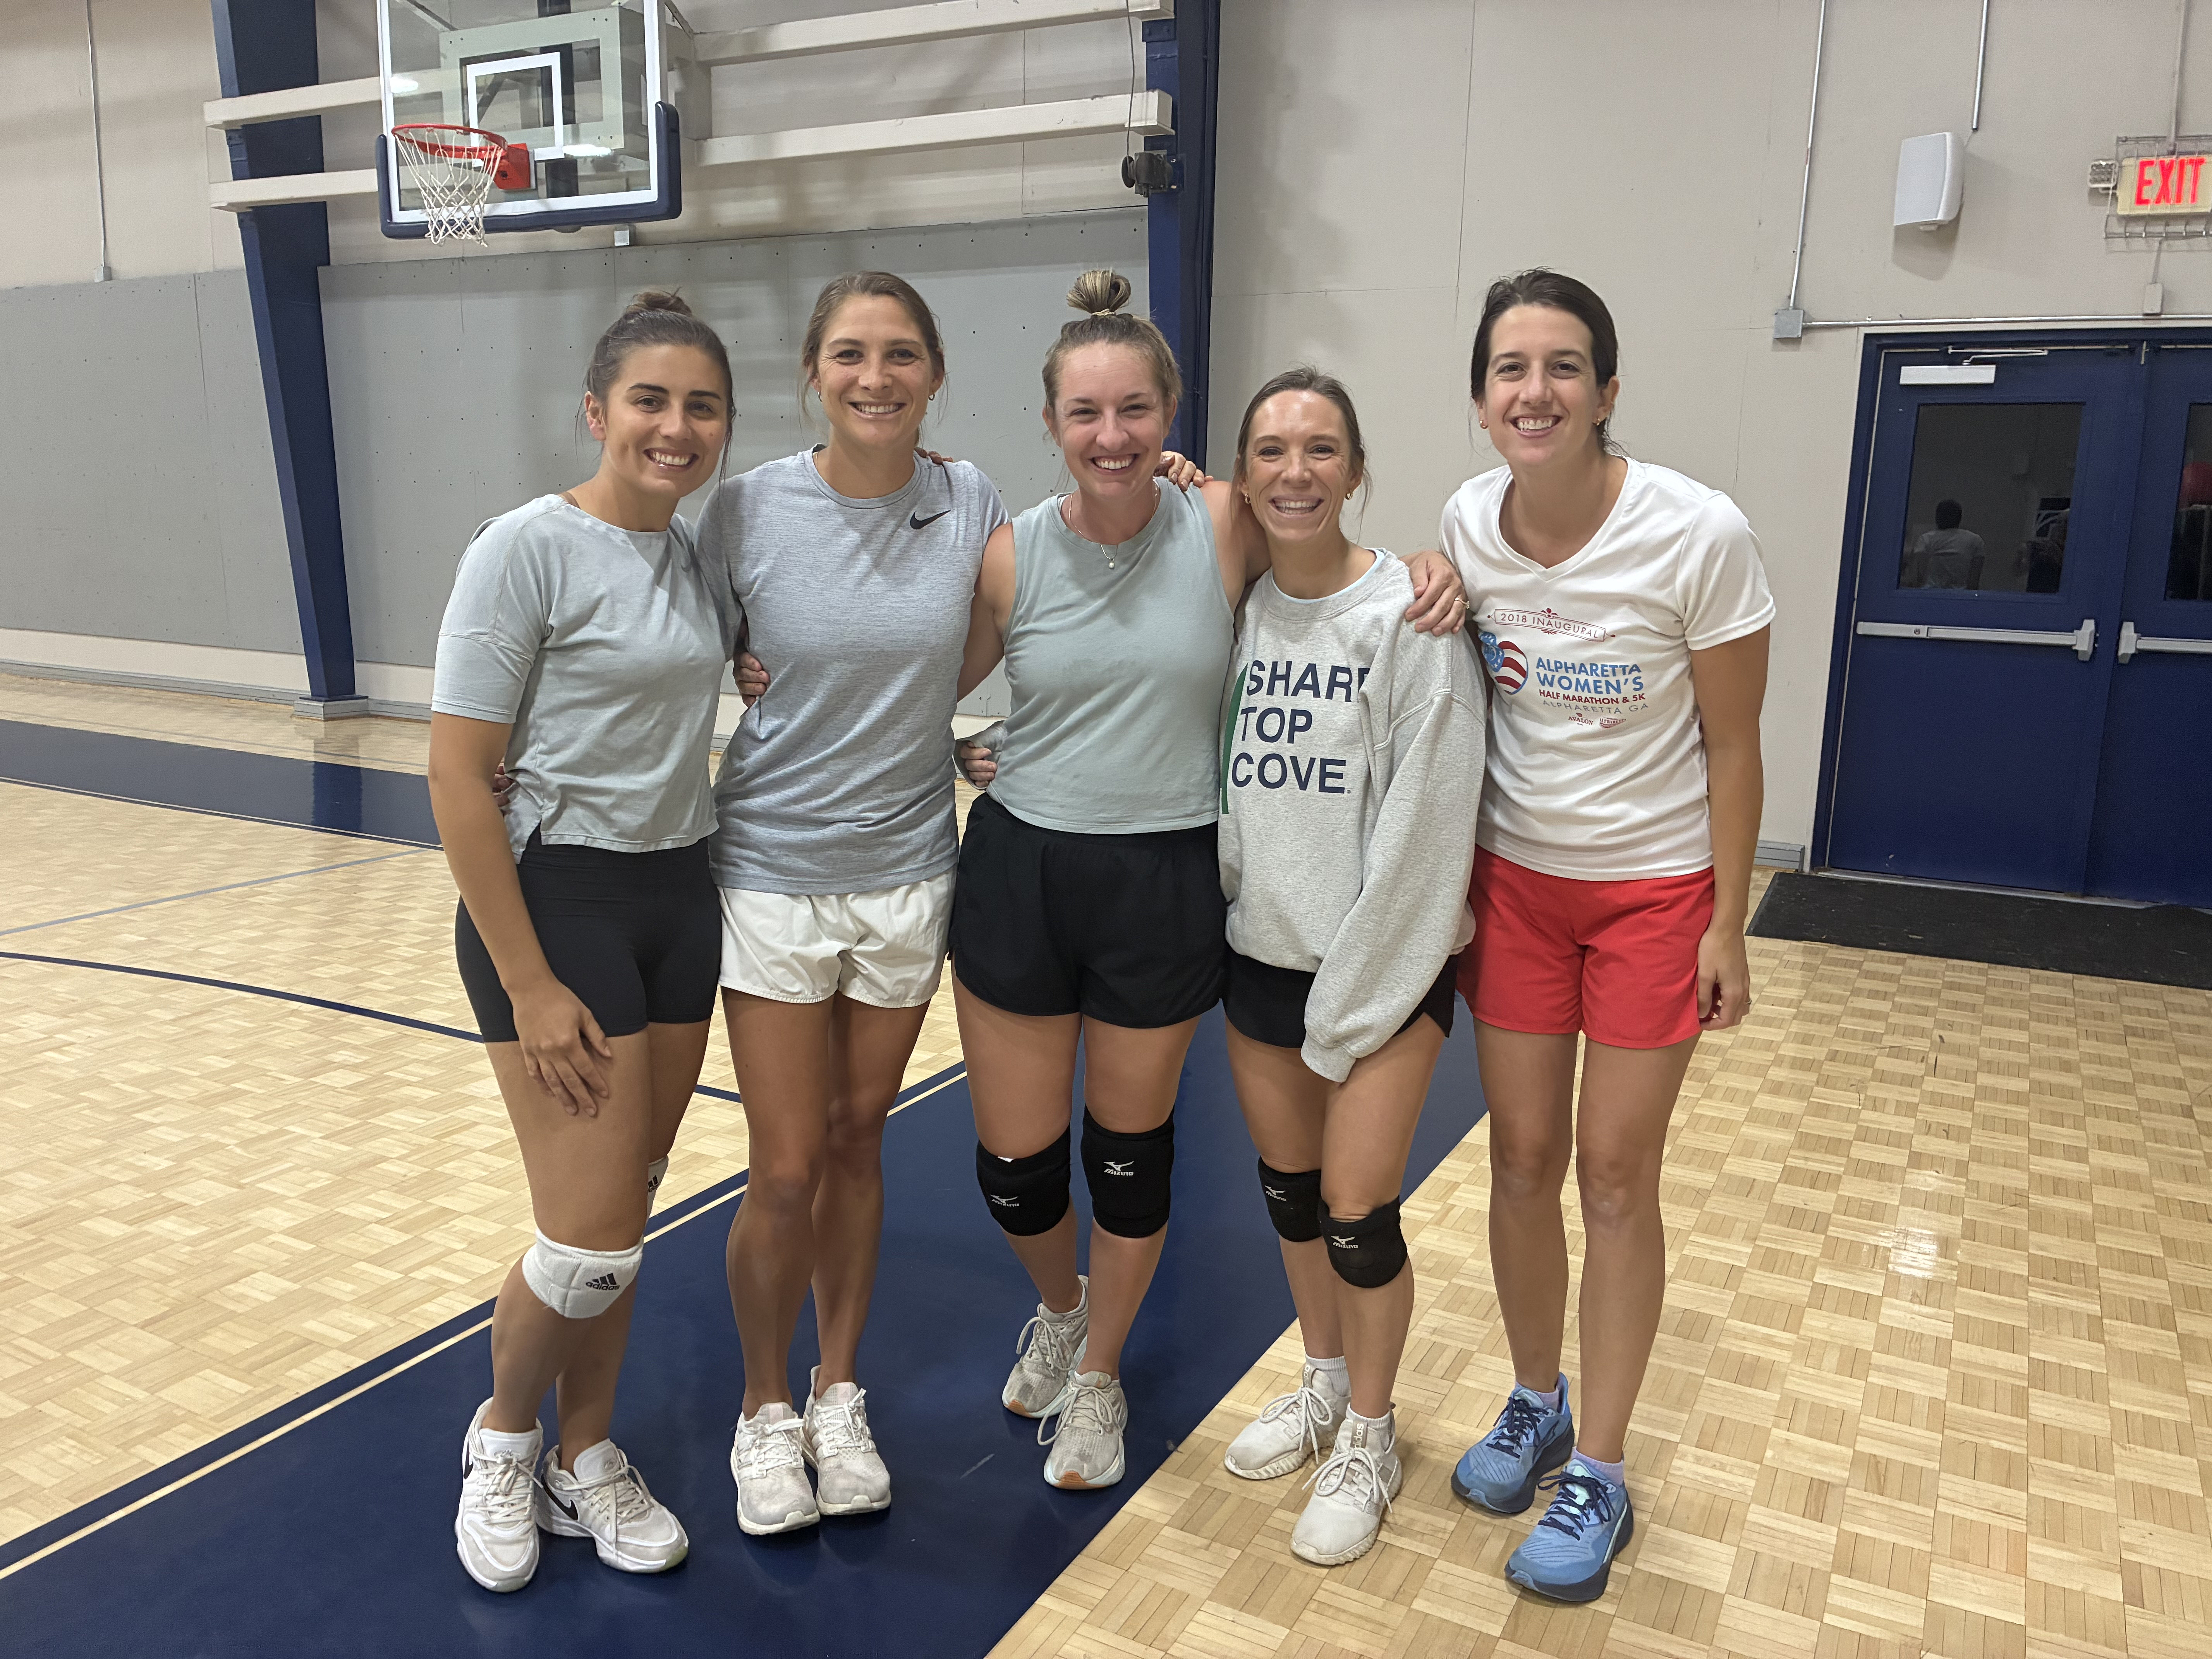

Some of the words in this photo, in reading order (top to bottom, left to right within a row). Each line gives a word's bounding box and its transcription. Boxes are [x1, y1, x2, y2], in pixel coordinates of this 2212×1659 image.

[2135, 157, 2206, 206] EXIT
[1501, 613, 1527, 623] 2018
[1533, 617, 1598, 638] INAUGURAL
[1536, 657, 1642, 677] ALPHARETTA
[1536, 672, 1644, 694] WOMEN'S
[1539, 689, 1560, 699] HALF
[1563, 694, 1619, 704] MARATHON
[1632, 693, 1646, 702] 5K
[1543, 700, 1621, 714] ALPHARETTA
[1629, 703, 1648, 712] GA
[1240, 706, 1312, 744] TOP
[1568, 716, 1594, 725] AVALON
[1232, 752, 1346, 793] COVE
[586, 1282, 620, 1291] adidas
